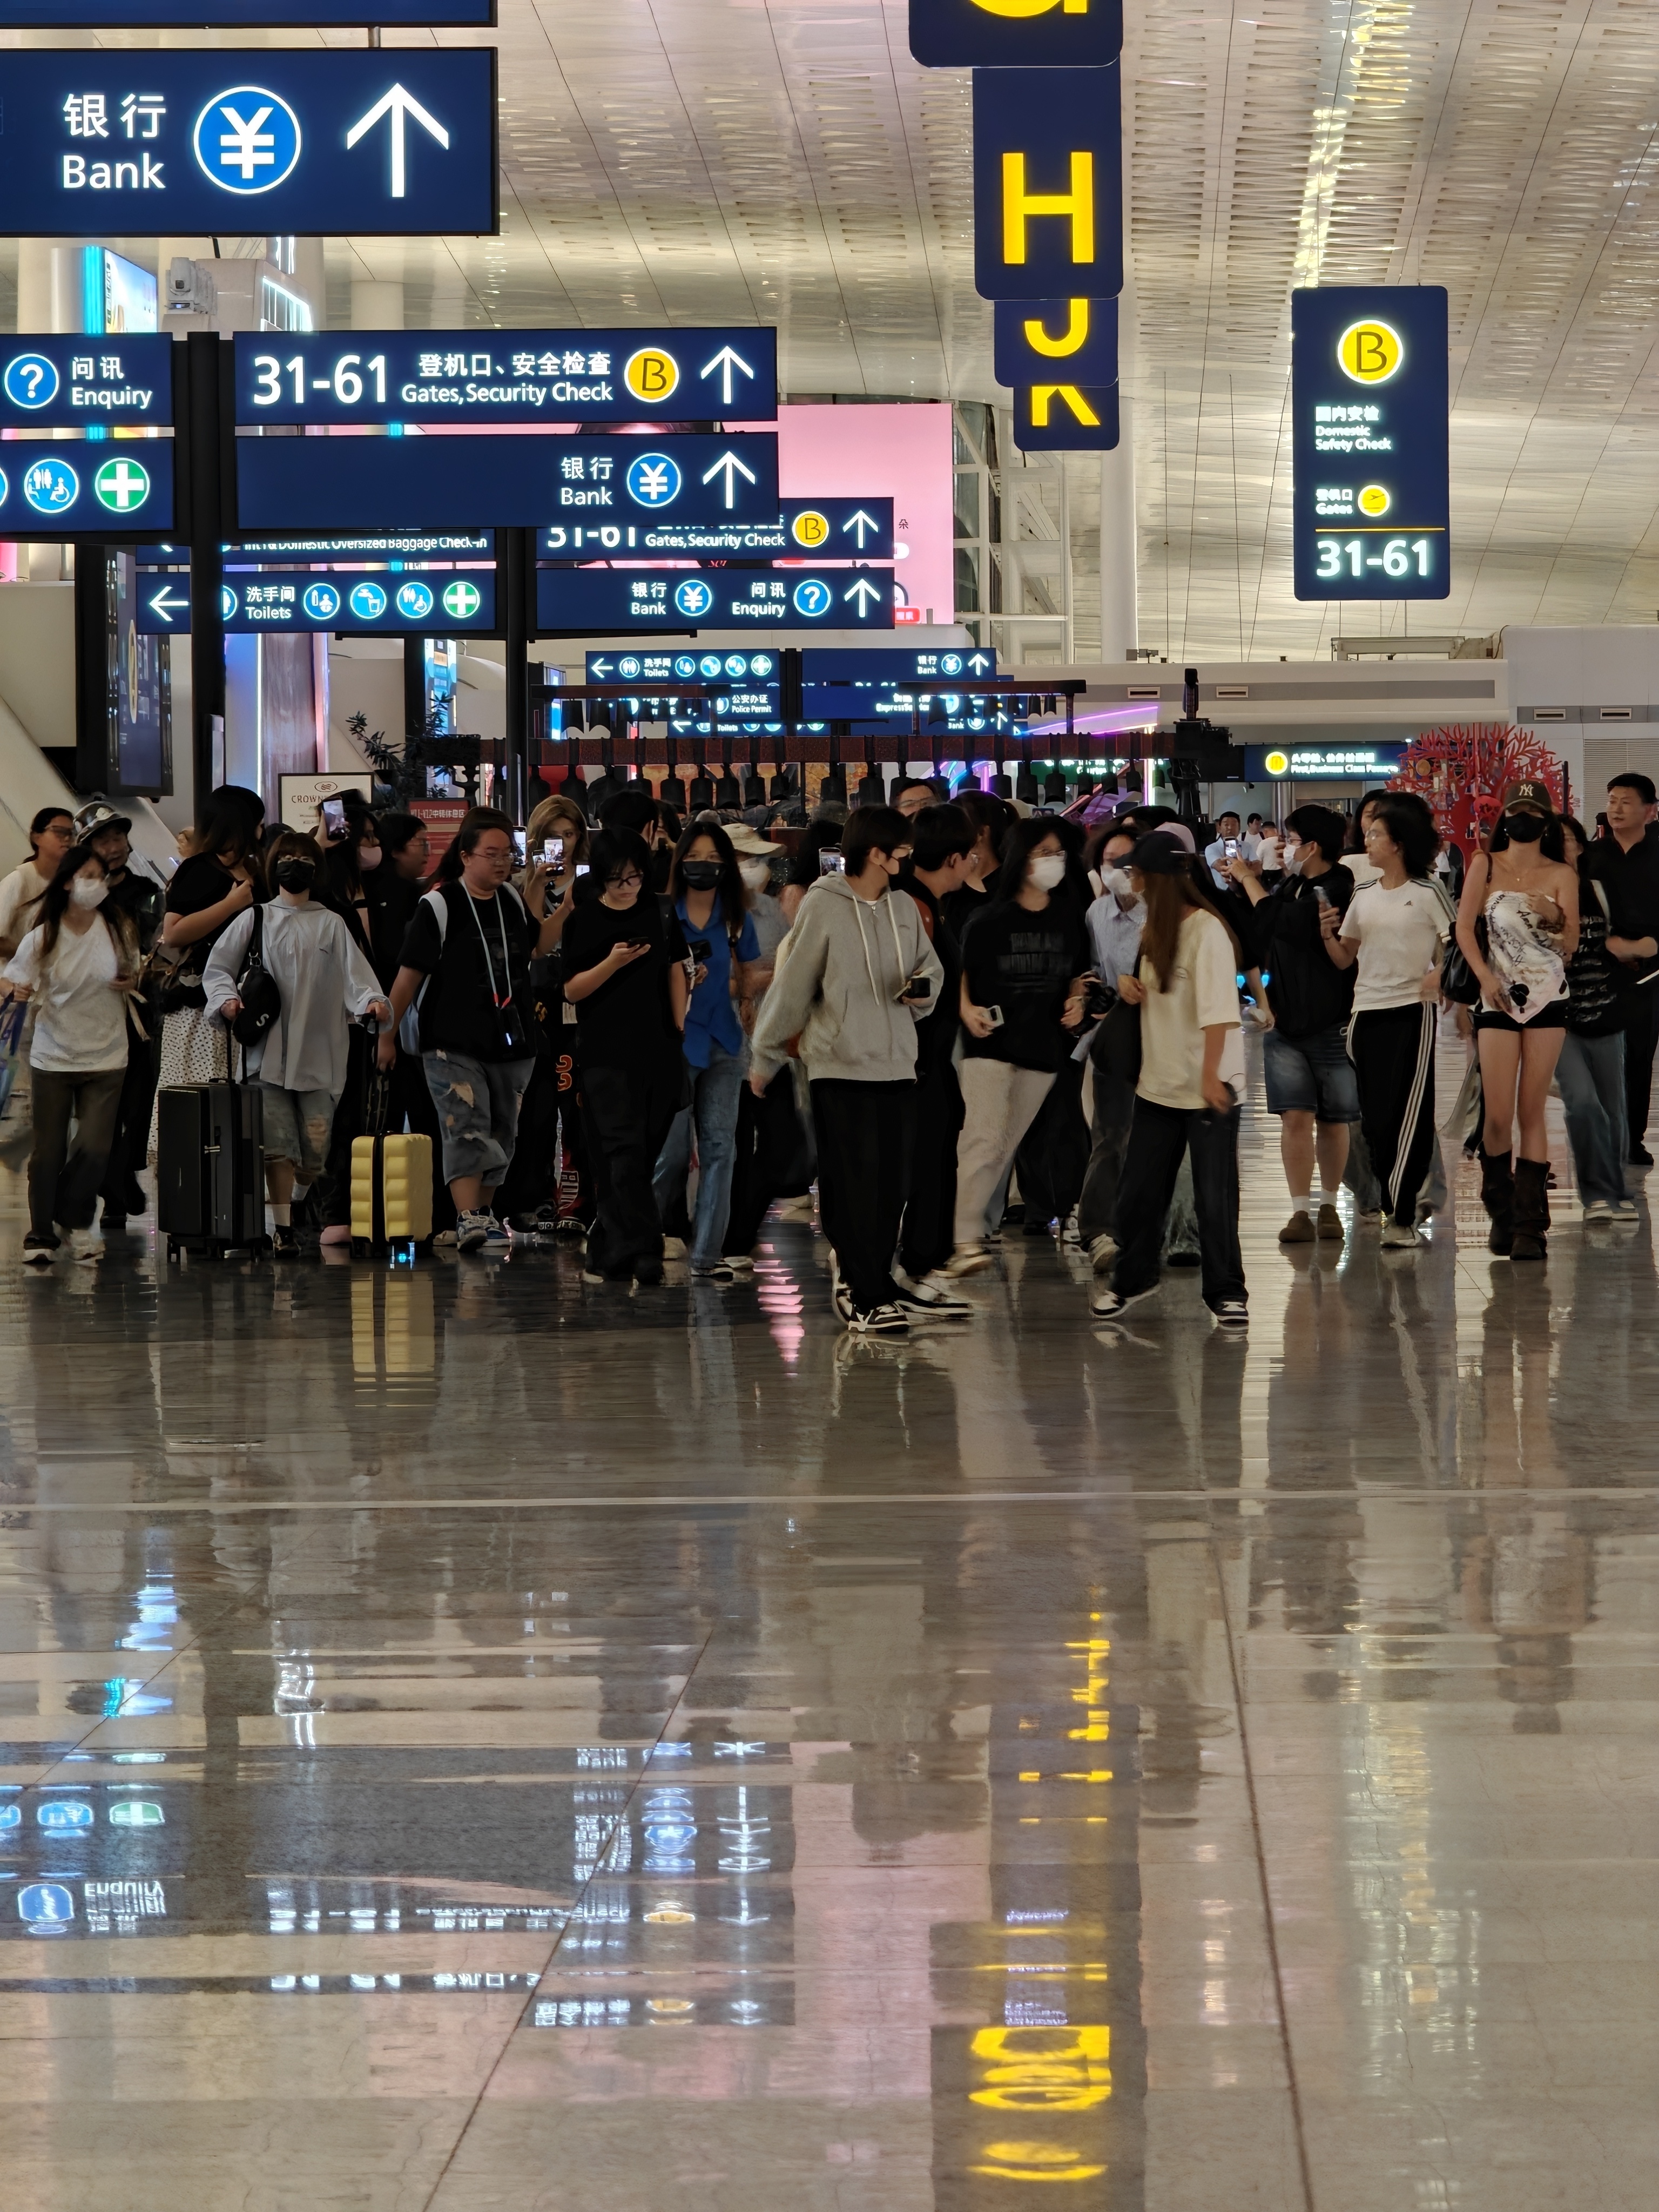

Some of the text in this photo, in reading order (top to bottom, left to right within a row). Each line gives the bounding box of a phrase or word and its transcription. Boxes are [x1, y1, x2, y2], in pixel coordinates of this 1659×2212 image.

[63, 93, 166, 138] 银行
[63, 153, 166, 189] Bank
[1003, 152, 1094, 264] H
[1024, 299, 1088, 357] J
[1357, 332, 1387, 372] B
[72, 356, 125, 380] 问讯
[419, 351, 611, 377] 登机口、安全检查
[253, 354, 386, 405] 31-61
[642, 358, 667, 391] B
[72, 386, 153, 409] Enquiry
[552, 382, 613, 402] Check
[1316, 424, 1371, 436] Domestic
[1316, 437, 1392, 453] Safety Check
[561, 457, 613, 480] 银行
[561, 487, 613, 505] Bank
[1316, 502, 1353, 515] Gates
[805, 518, 820, 540] B
[388, 538, 437, 551] Baggage
[439, 536, 487, 548] Check-in
[744, 532, 786, 547] Check
[1316, 539, 1428, 577] 31-61
[246, 586, 295, 602] 洗手间
[631, 582, 667, 598] 银行
[751, 582, 786, 598] 问讯
[245, 605, 292, 619] Toilets
[631, 601, 666, 615] Bank
[732, 602, 786, 618] Enquiry
[644, 658, 671, 667] 洗手间
[918, 655, 938, 665] 银行
[643, 669, 669, 677] Toilets
[918, 666, 937, 675] Bank
[732, 694, 768, 704] 公安办证
[731, 705, 772, 713] Police Permit
[717, 724, 738, 732] Toilets
